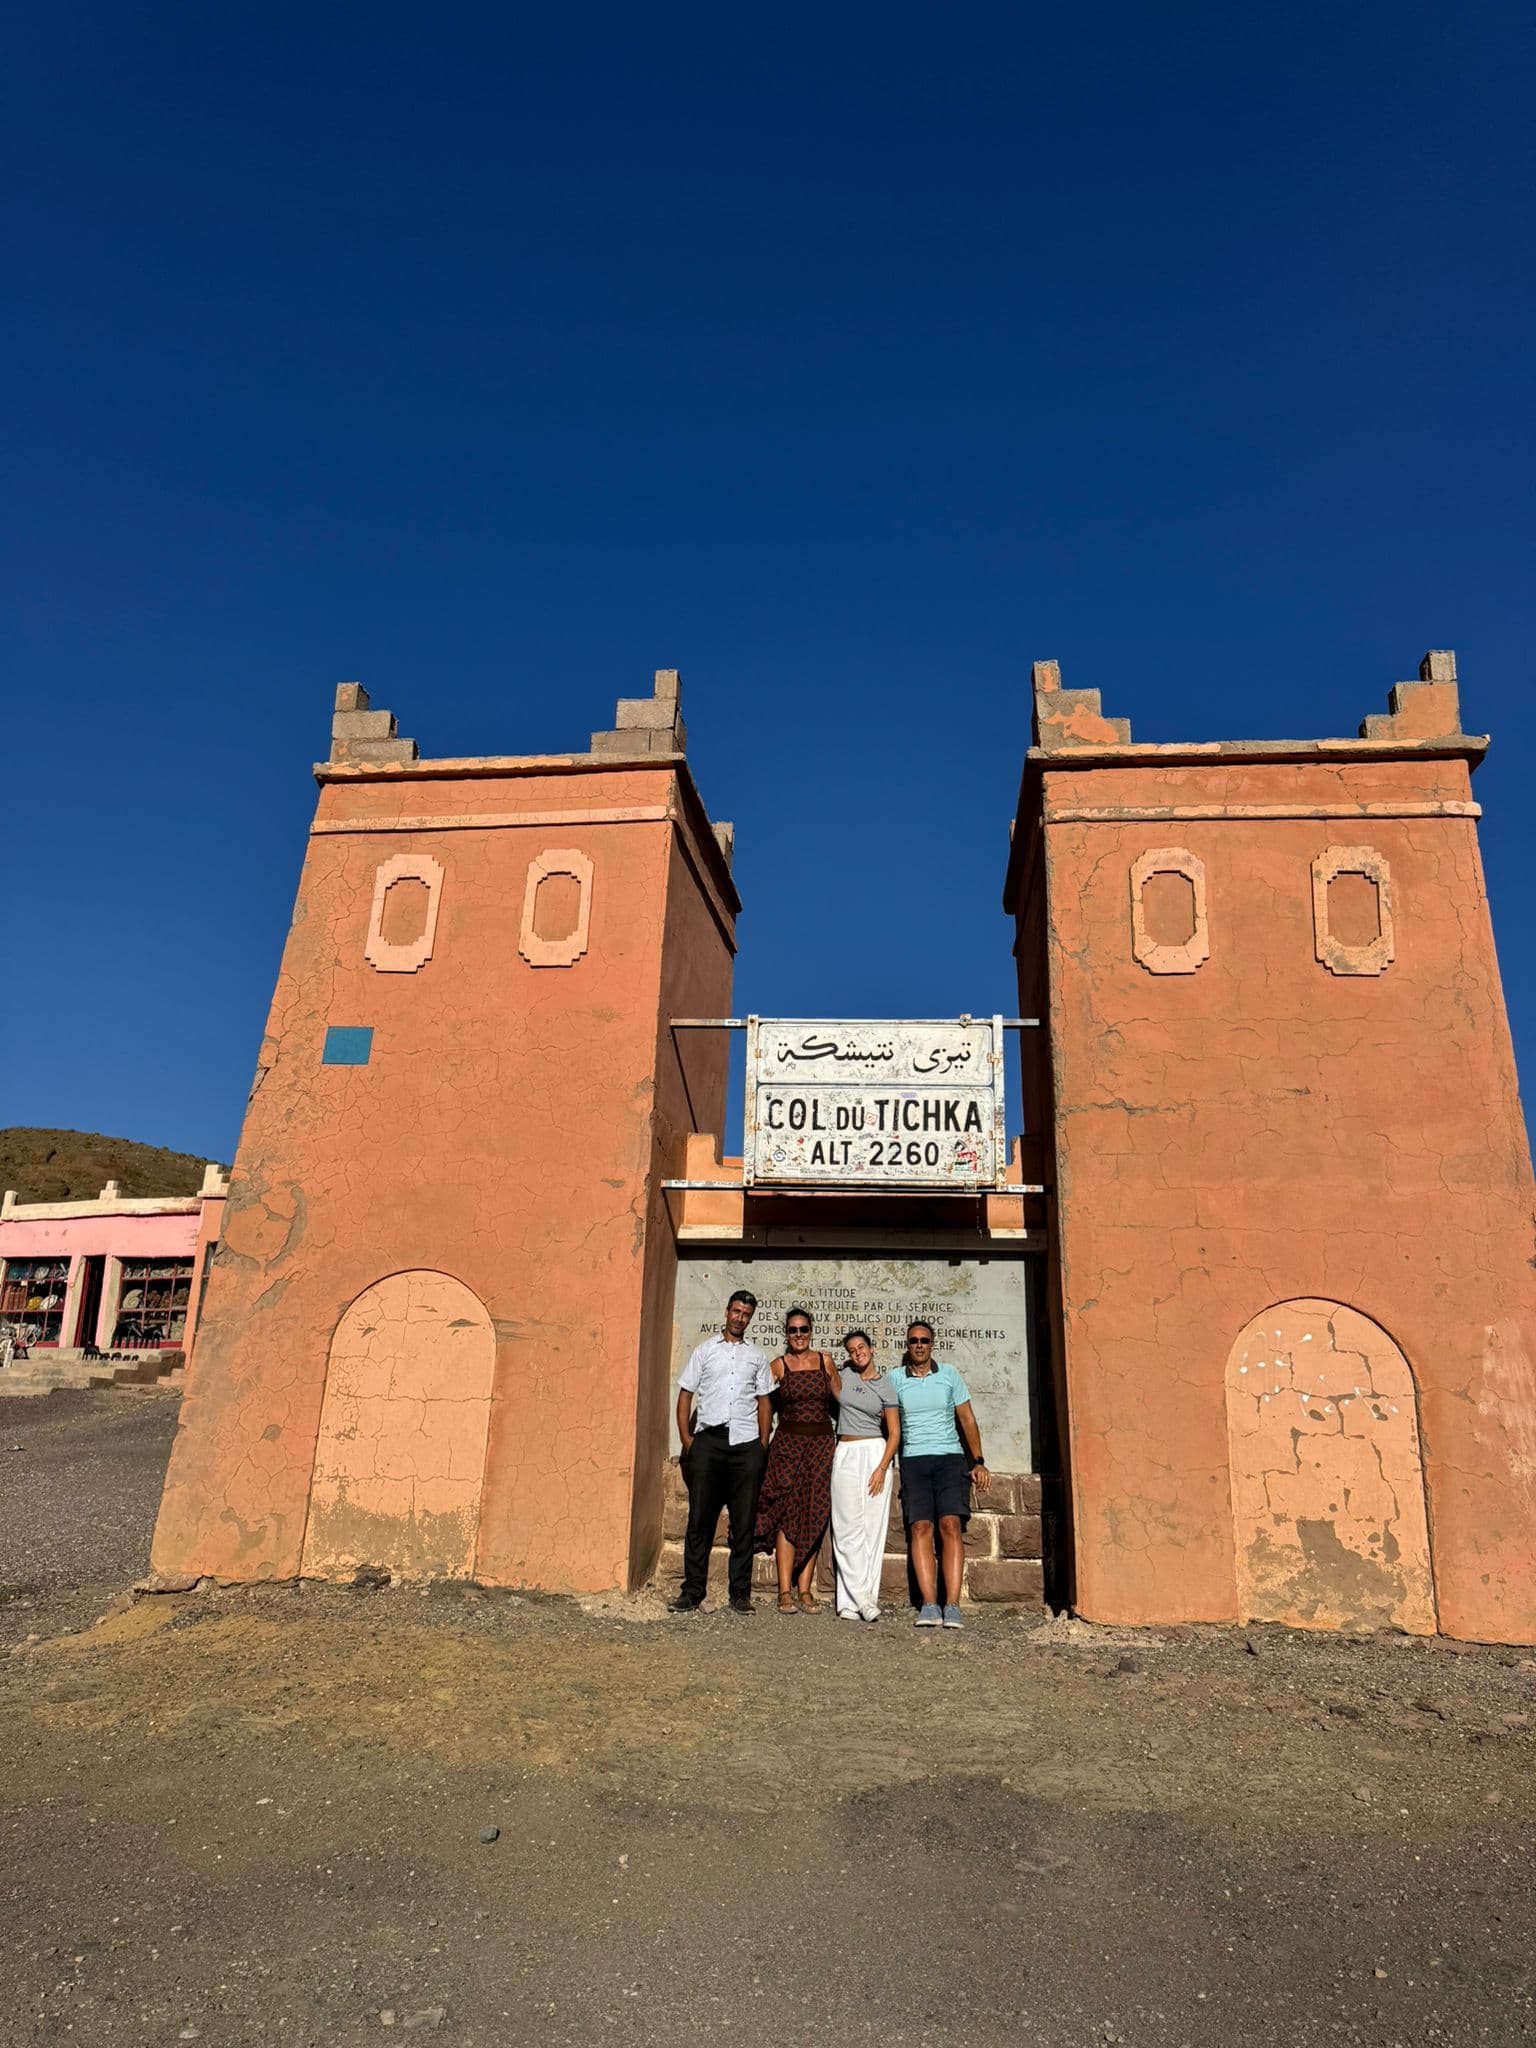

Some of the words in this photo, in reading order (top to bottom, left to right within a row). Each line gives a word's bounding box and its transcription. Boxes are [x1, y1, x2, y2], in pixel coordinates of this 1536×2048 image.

[768, 1098, 826, 1131] COL
[837, 1106, 865, 1131] DU
[874, 1099, 983, 1133] TICHKA
[810, 1140, 853, 1165] ALT
[869, 1141, 939, 1166] 2260
[755, 1299, 786, 1309] OUTE
[791, 1300, 858, 1311] CONSTRUITE
[864, 1301, 884, 1311] PAR
[908, 1302, 954, 1313] SERVICE
[758, 1312, 779, 1321] DES
[835, 1313, 881, 1323] PUBLICS
[886, 1314, 900, 1324] DU
[815, 1326, 829, 1335] DU
[884, 1327, 906, 1336] DES
[763, 1337, 778, 1346] DU
